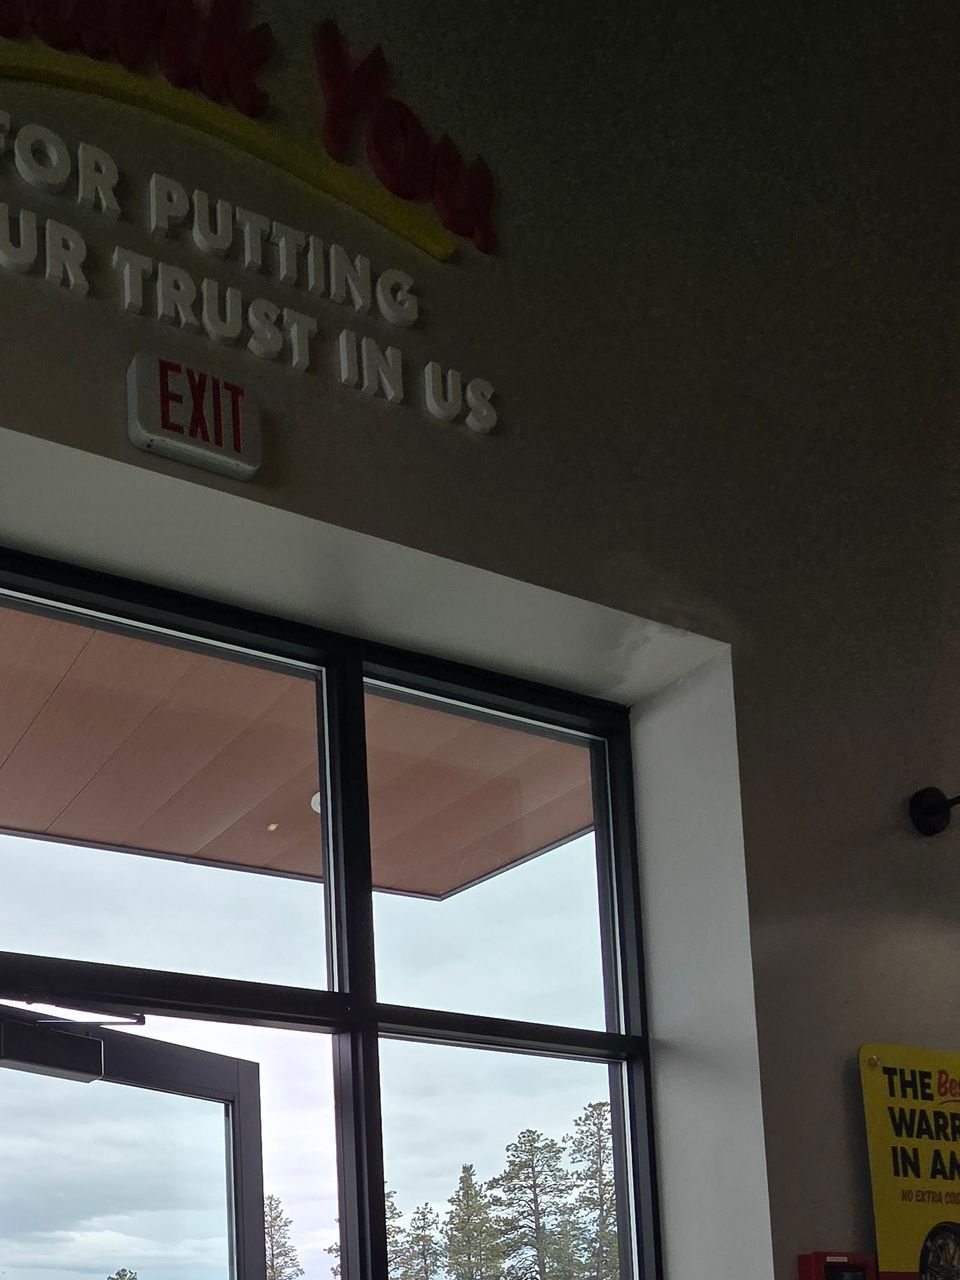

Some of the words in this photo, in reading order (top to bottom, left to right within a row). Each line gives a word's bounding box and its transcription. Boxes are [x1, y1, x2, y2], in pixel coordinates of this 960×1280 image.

[149, 171, 420, 327] PUTTING
[112, 245, 319, 371] TRUST
[339, 329, 403, 404] IN
[424, 360, 499, 435] US
[158, 359, 245, 453] EXIT
[882, 1066, 935, 1102] THE
[937, 1069, 960, 1098] Be
[891, 1146, 921, 1178] IN
[901, 1189, 914, 1203] NO
[915, 1190, 943, 1204] EXTRA
